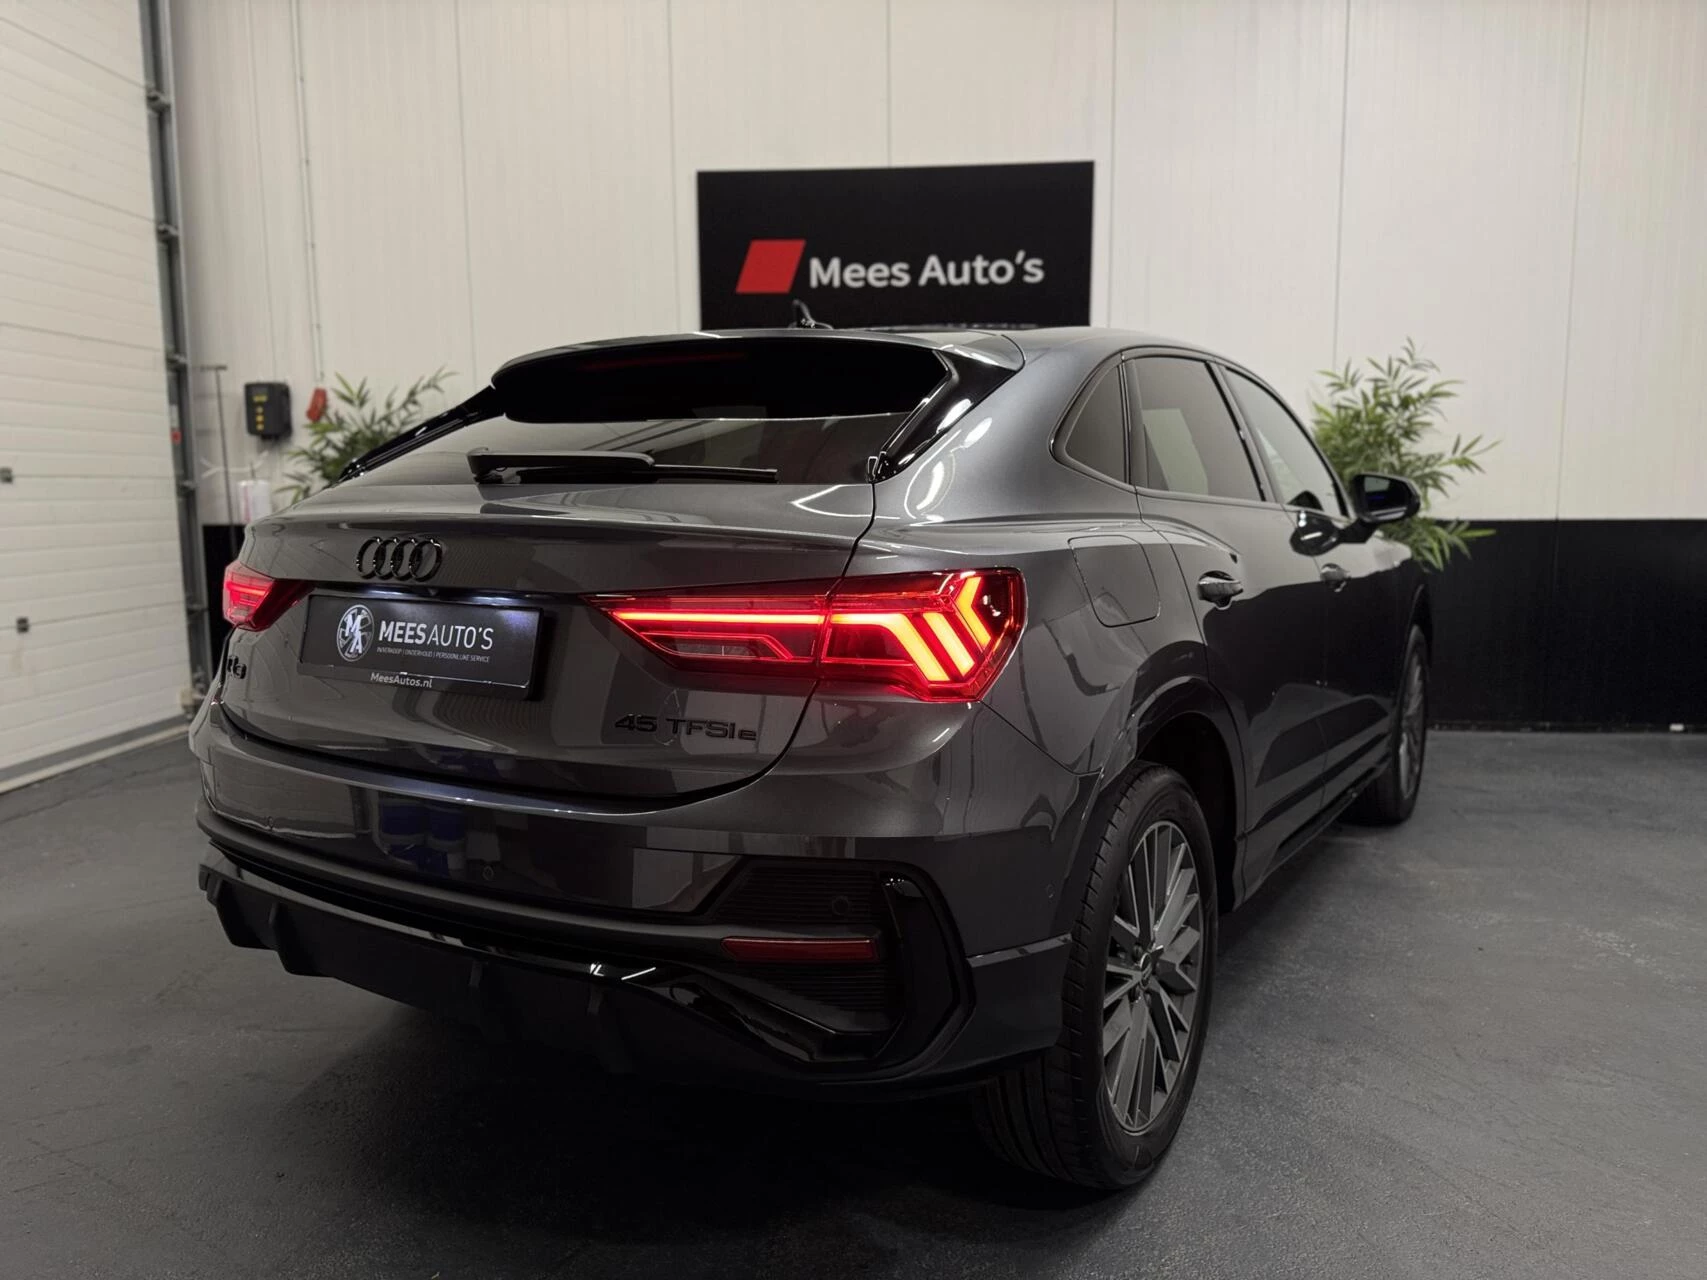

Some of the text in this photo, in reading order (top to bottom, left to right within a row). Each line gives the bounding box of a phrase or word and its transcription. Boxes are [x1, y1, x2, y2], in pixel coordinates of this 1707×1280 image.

[809, 249, 1045, 289] Mees Auto's
[378, 620, 494, 650] MEES AUTO'S
[470, 654, 490, 662] SERVICE
[370, 672, 433, 688] MeesAutos.nl
[615, 714, 657, 732] 45
